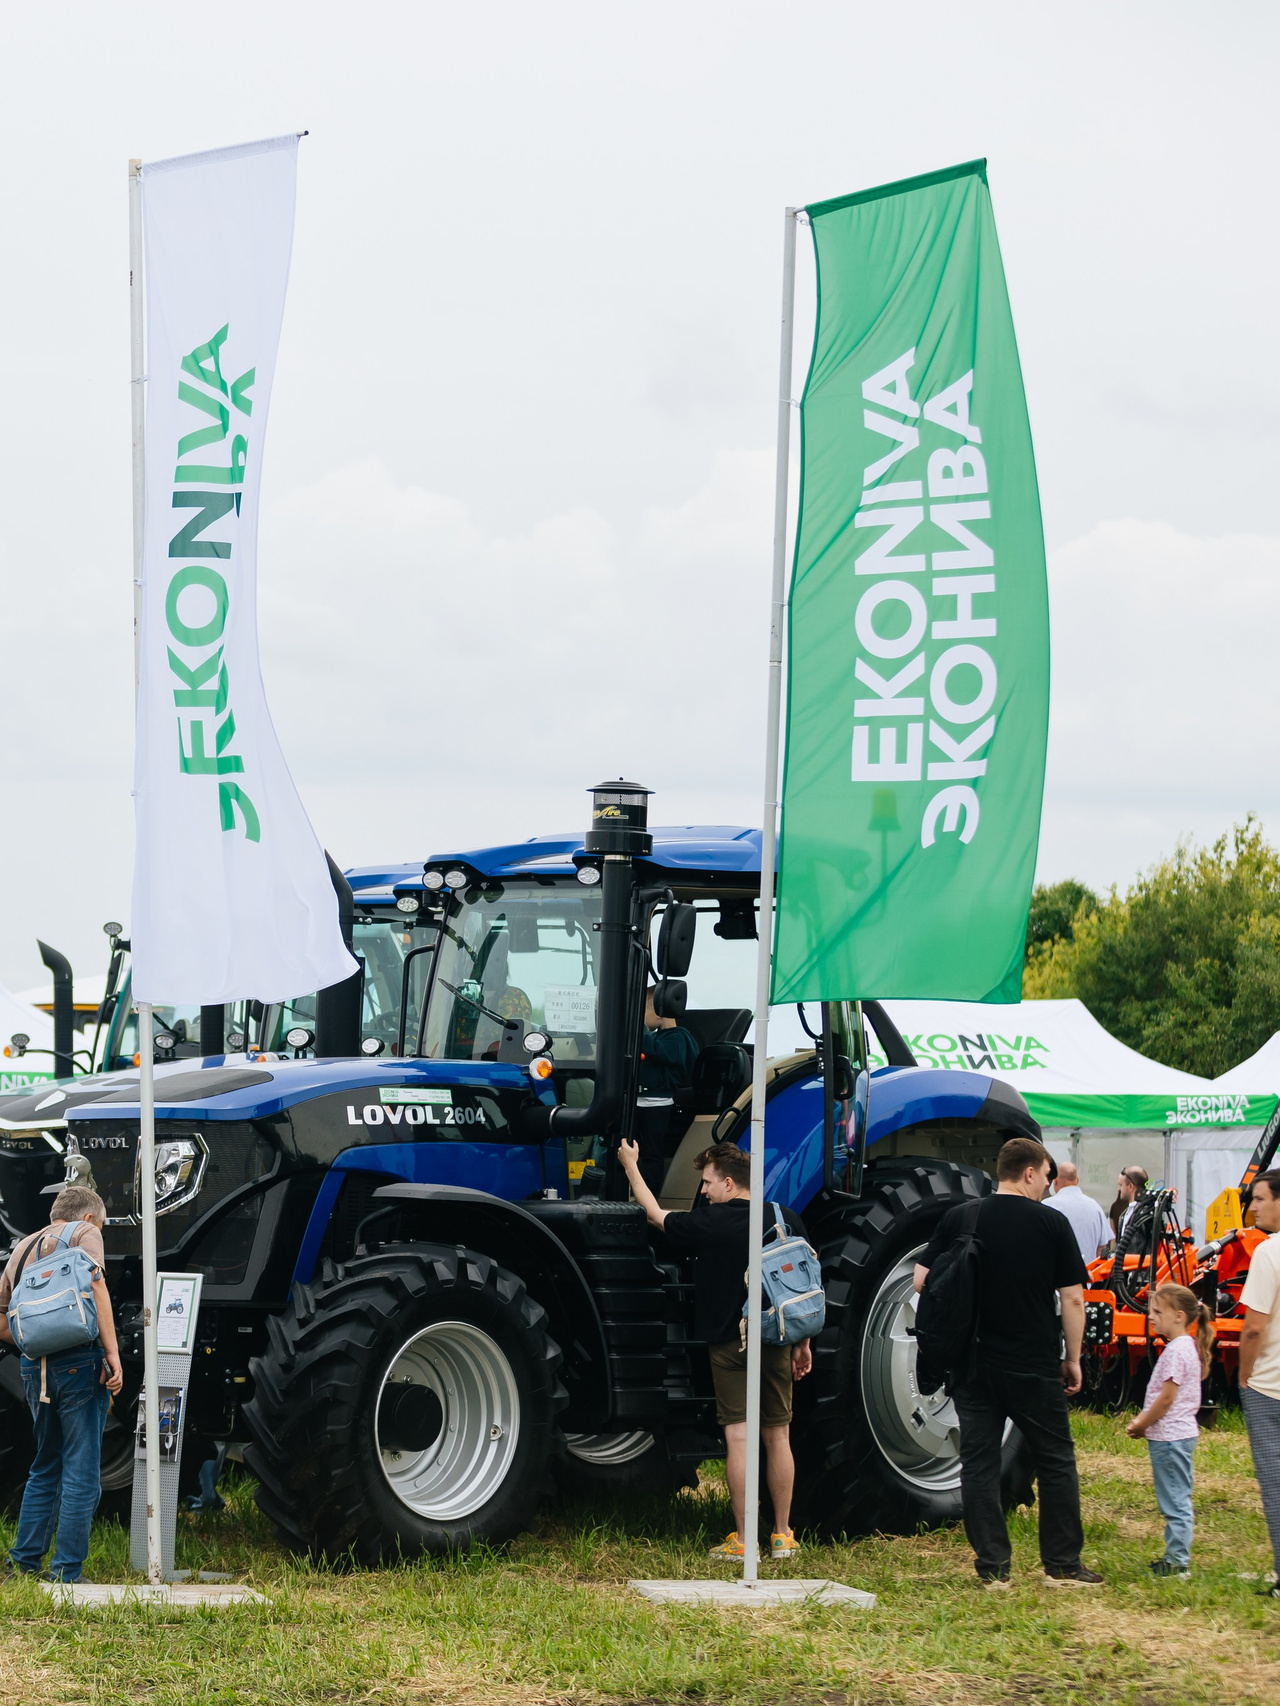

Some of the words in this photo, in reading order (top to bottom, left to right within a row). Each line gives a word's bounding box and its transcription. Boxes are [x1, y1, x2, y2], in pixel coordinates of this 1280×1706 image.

[165, 322, 233, 775] EKONIVA
[851, 346, 927, 782] EKONIVA
[921, 369, 997, 849] ЭКОНИВА
[571, 1002, 590, 1010] 00126
[877, 1034, 1051, 1053] KONIVA
[1176, 1095, 1250, 1111] EKONIVA
[347, 1105, 440, 1125] LOVOL
[444, 1107, 486, 1125] 2604
[1165, 1109, 1246, 1125] ЭКОНИВА
[82, 1137, 129, 1149] LOVOL
[1257, 1107, 1280, 1160] LIUGO
[1213, 1220, 1218, 1234] 2
